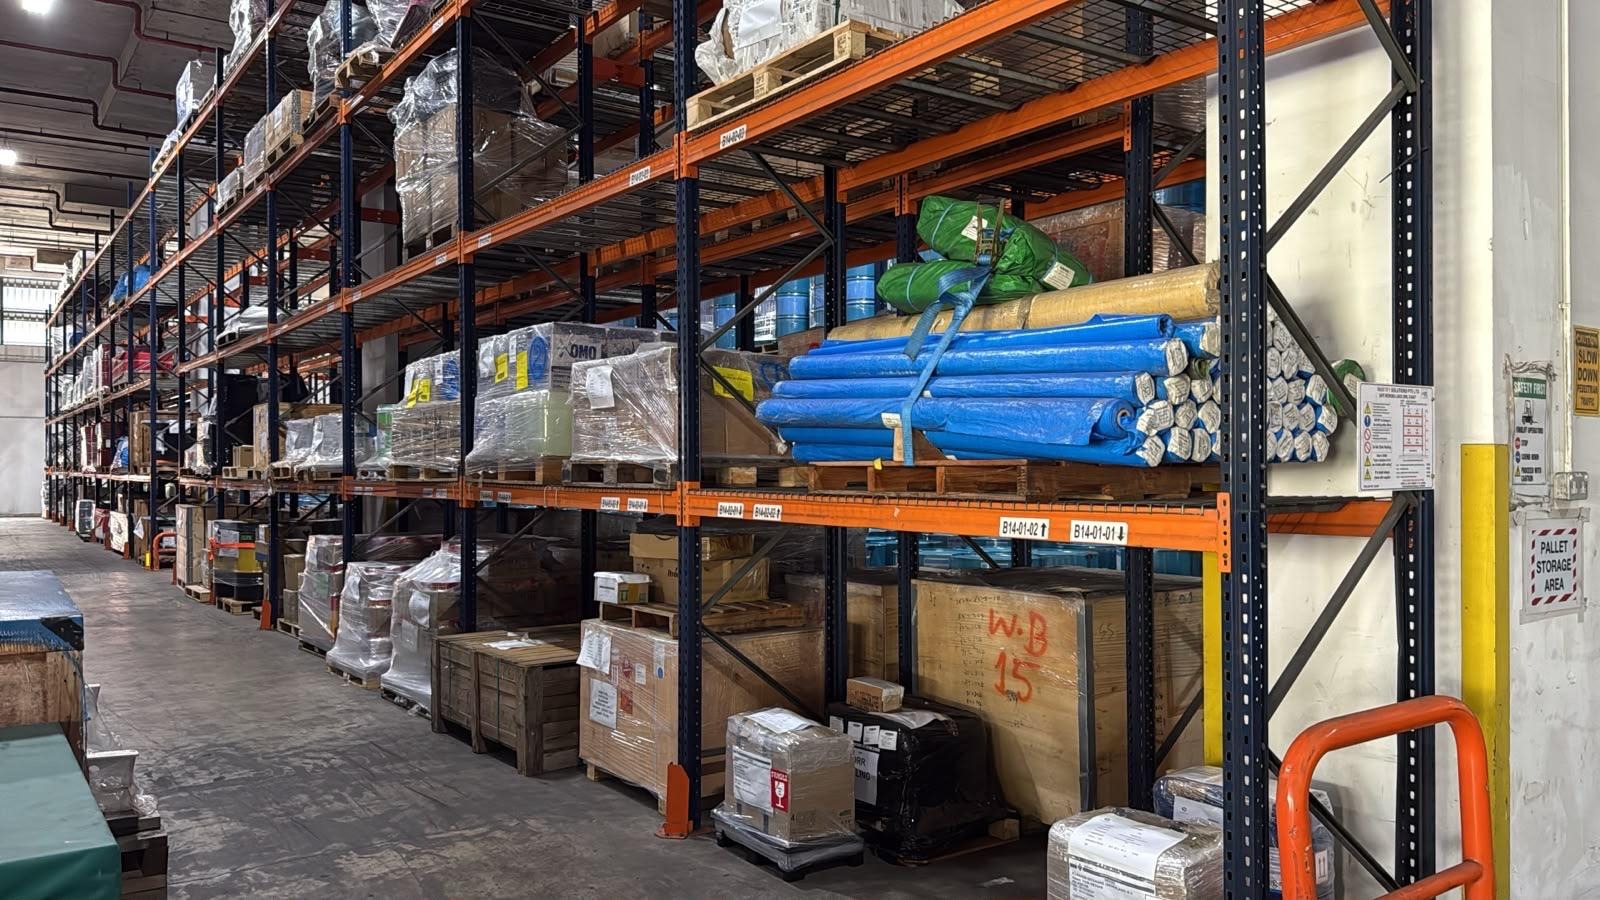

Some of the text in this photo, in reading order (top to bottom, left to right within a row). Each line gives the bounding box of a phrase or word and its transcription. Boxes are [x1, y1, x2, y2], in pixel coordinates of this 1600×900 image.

[570, 344, 597, 360] OMO
[1578, 350, 1597, 364] SLOW
[1578, 368, 1598, 382] DOWN
[1514, 381, 1546, 395] SAFETY FIRST
[1002, 521, 1039, 536] B14-01-02
[1074, 524, 1115, 540] B14-01-01
[1540, 540, 1568, 554] PALLET
[1536, 558, 1571, 573] STORAGE
[1544, 577, 1564, 592] AREA
[988, 608, 1048, 657] W.B
[993, 651, 1041, 703] 15
